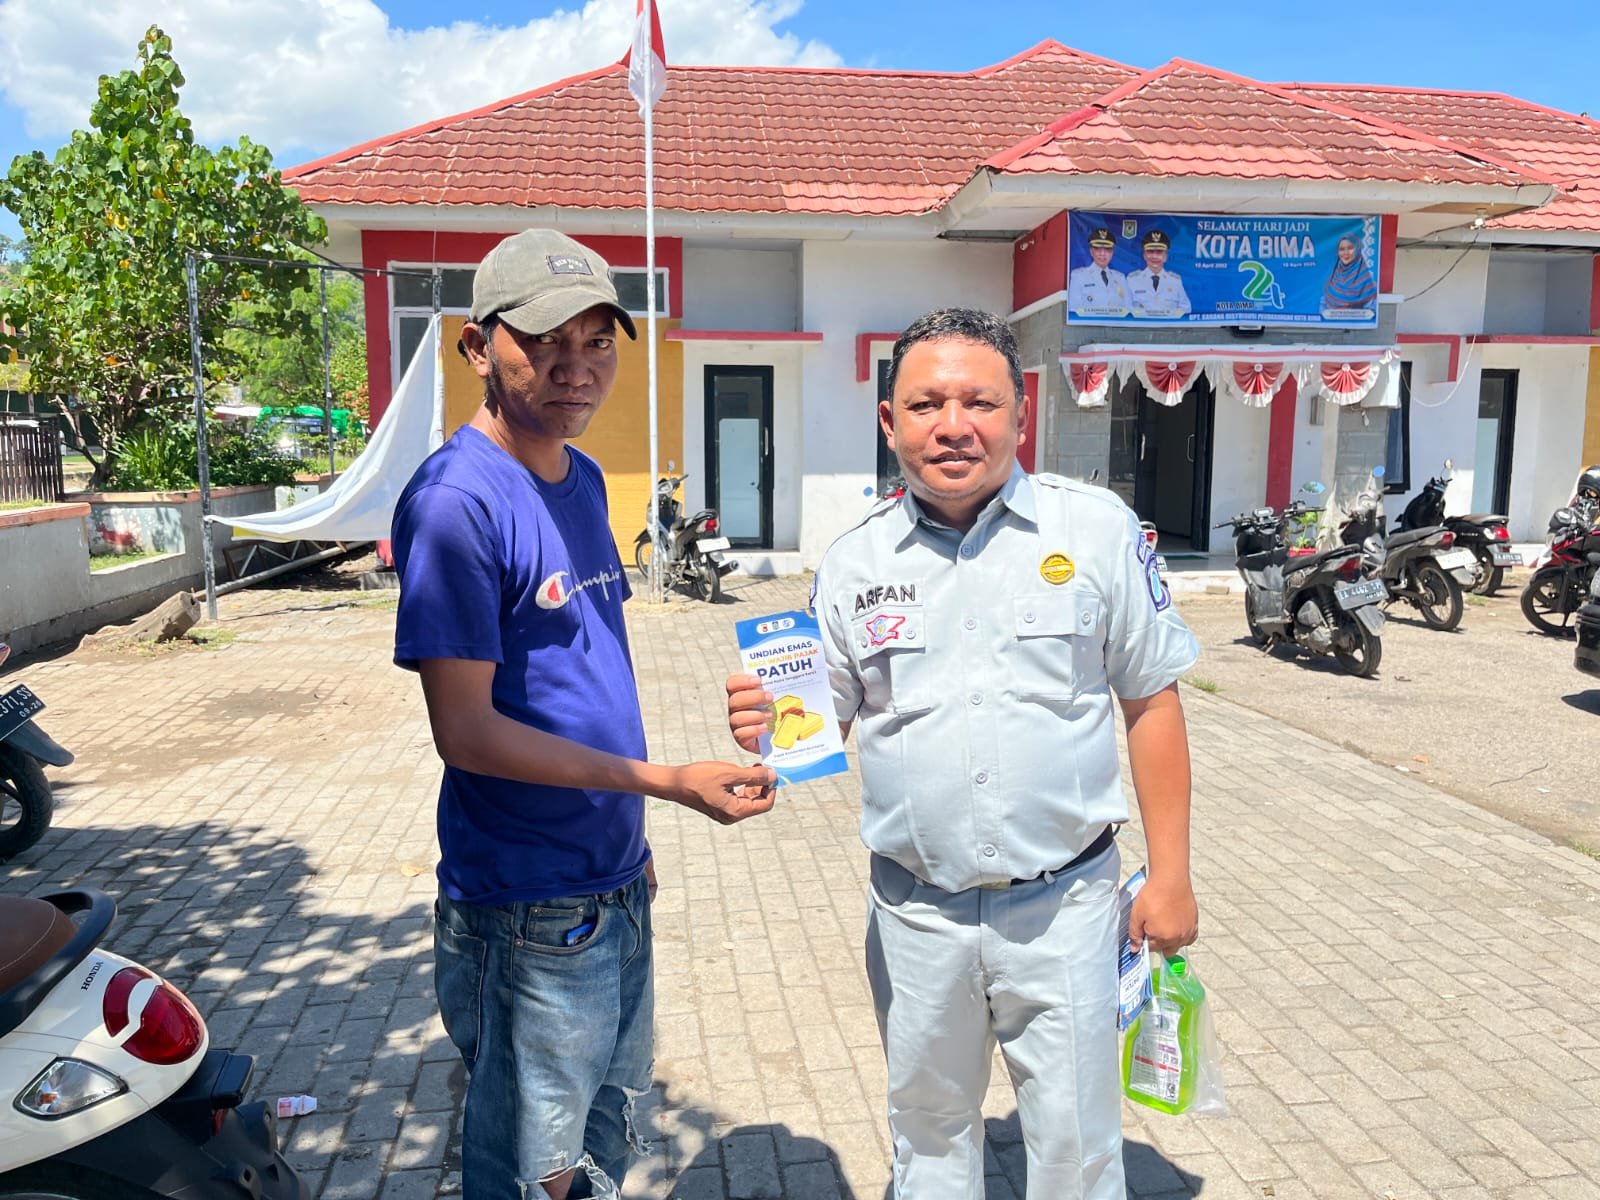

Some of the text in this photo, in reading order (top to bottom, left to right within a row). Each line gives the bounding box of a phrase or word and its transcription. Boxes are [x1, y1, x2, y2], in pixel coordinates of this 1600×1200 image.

[1197, 221, 1310, 234] SELAMAT HARI JADI
[1195, 234, 1315, 258] KOTA BIMA
[1216, 302, 1235, 311] KOTA
[855, 584, 915, 613] ARFAN
[749, 641, 813, 660] UNDIAN EMAS
[794, 648, 818, 659] PAJAK
[757, 657, 813, 678] PATUH
[81, 961, 104, 991] HONDA
